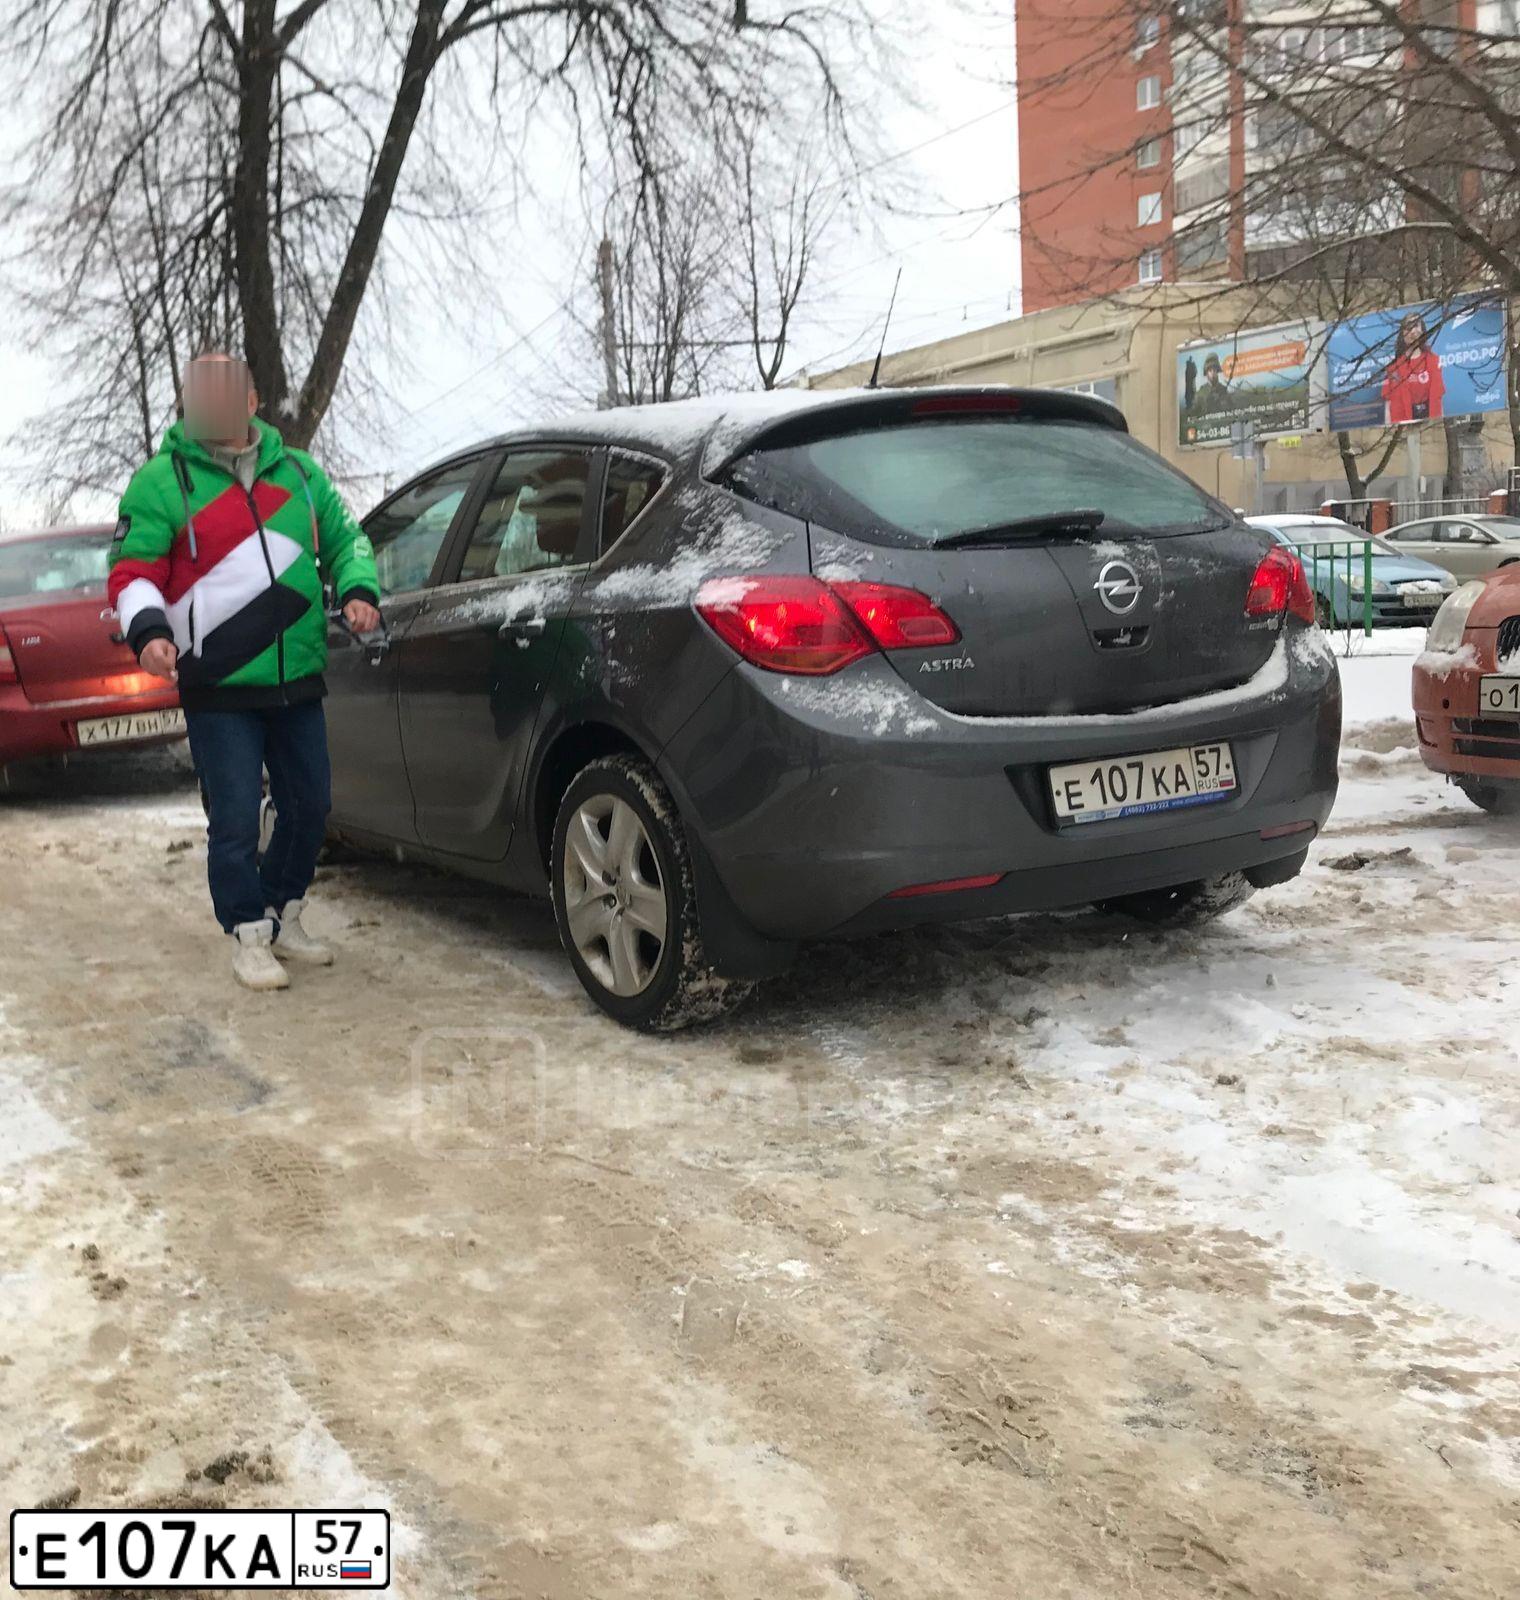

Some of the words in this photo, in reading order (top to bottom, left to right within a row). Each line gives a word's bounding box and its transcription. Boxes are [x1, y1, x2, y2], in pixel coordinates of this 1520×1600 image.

[1437, 347, 1501, 368] ДОБРО.РФ
[918, 655, 976, 673] ASTRA
[1194, 746, 1222, 778] 57
[1197, 777, 1219, 790] RUS
